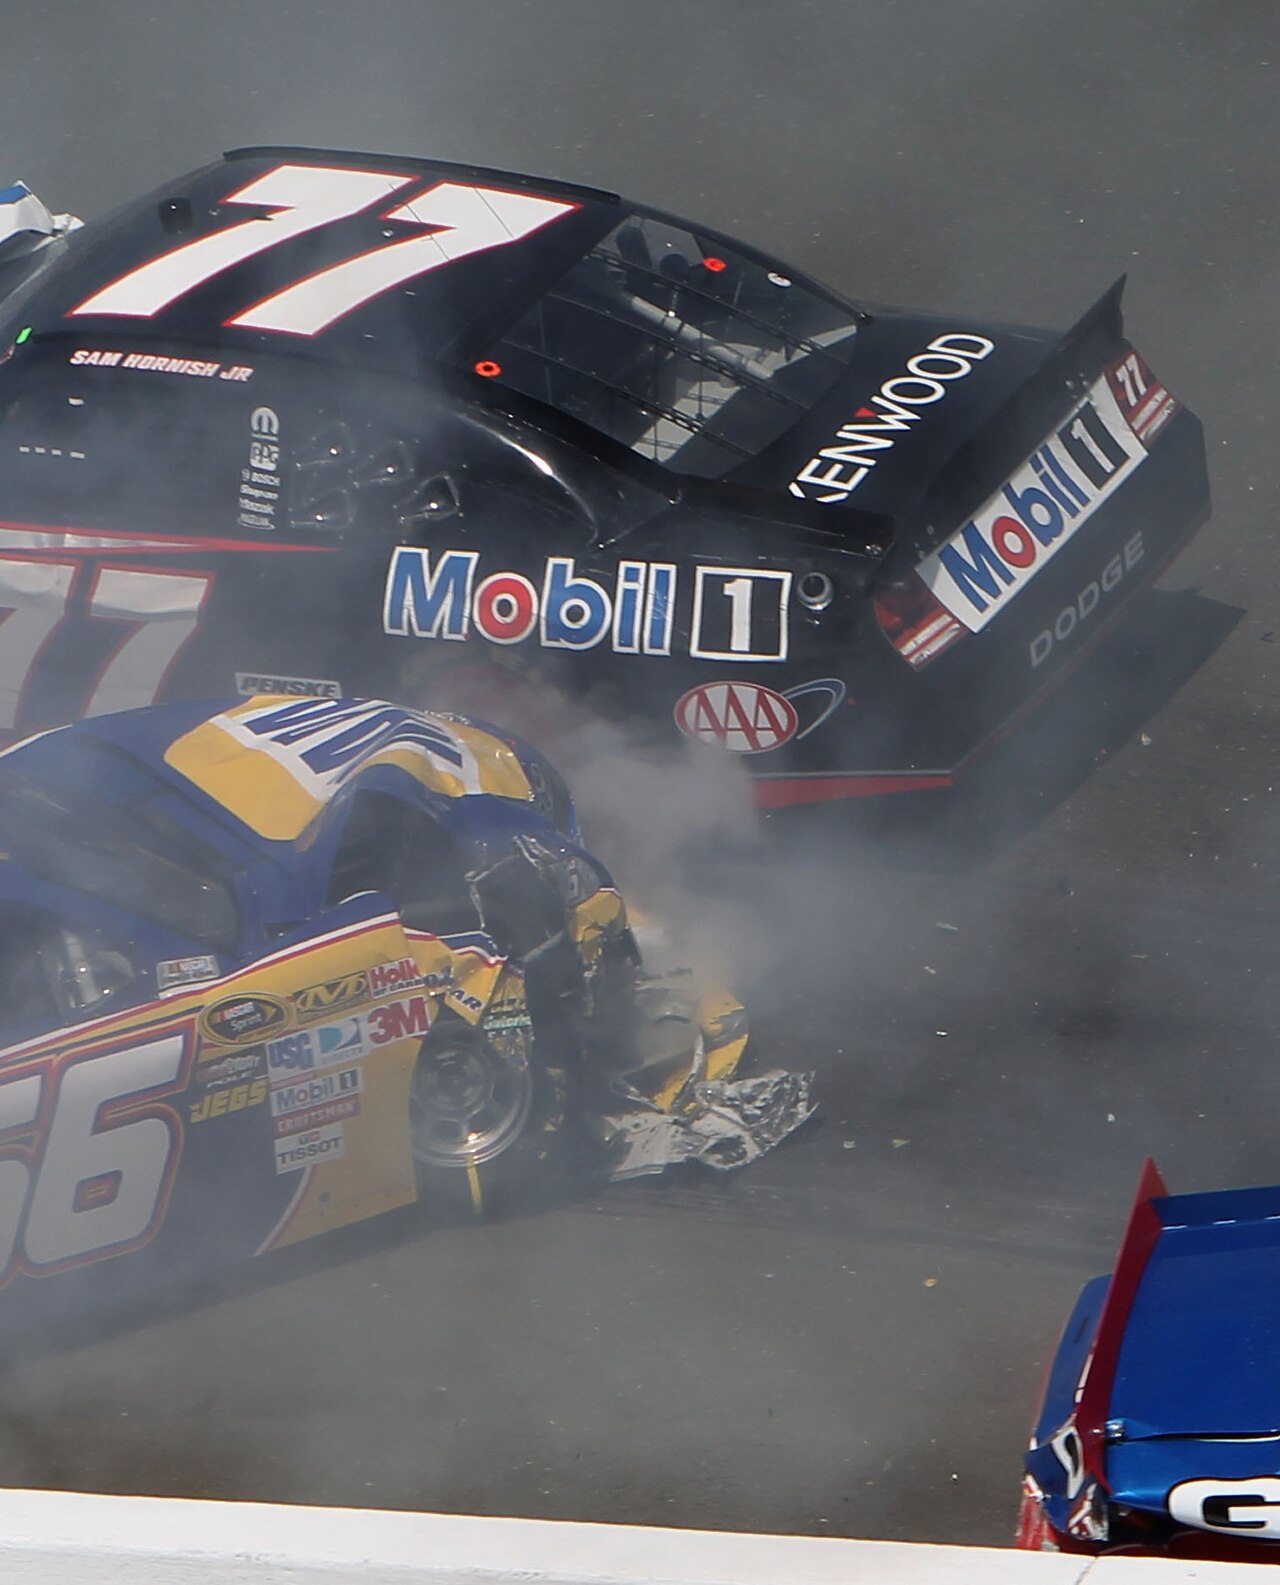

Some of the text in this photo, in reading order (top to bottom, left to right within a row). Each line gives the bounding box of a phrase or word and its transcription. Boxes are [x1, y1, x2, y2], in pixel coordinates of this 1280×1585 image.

[66, 164, 582, 337] 77
[70, 349, 255, 382] SAM HORNISH JR
[1115, 353, 1147, 407] 77
[937, 443, 1092, 614] Mobil
[383, 546, 677, 656] Mobil
[1030, 530, 1145, 668] DODGE
[239, 676, 338, 698] PENSKE
[692, 683, 796, 752] AAA
[369, 997, 429, 1044] 3M
[190, 1081, 268, 1123] JEGS
[277, 1077, 334, 1108] Mobil
[277, 1136, 342, 1164] TISSOT
